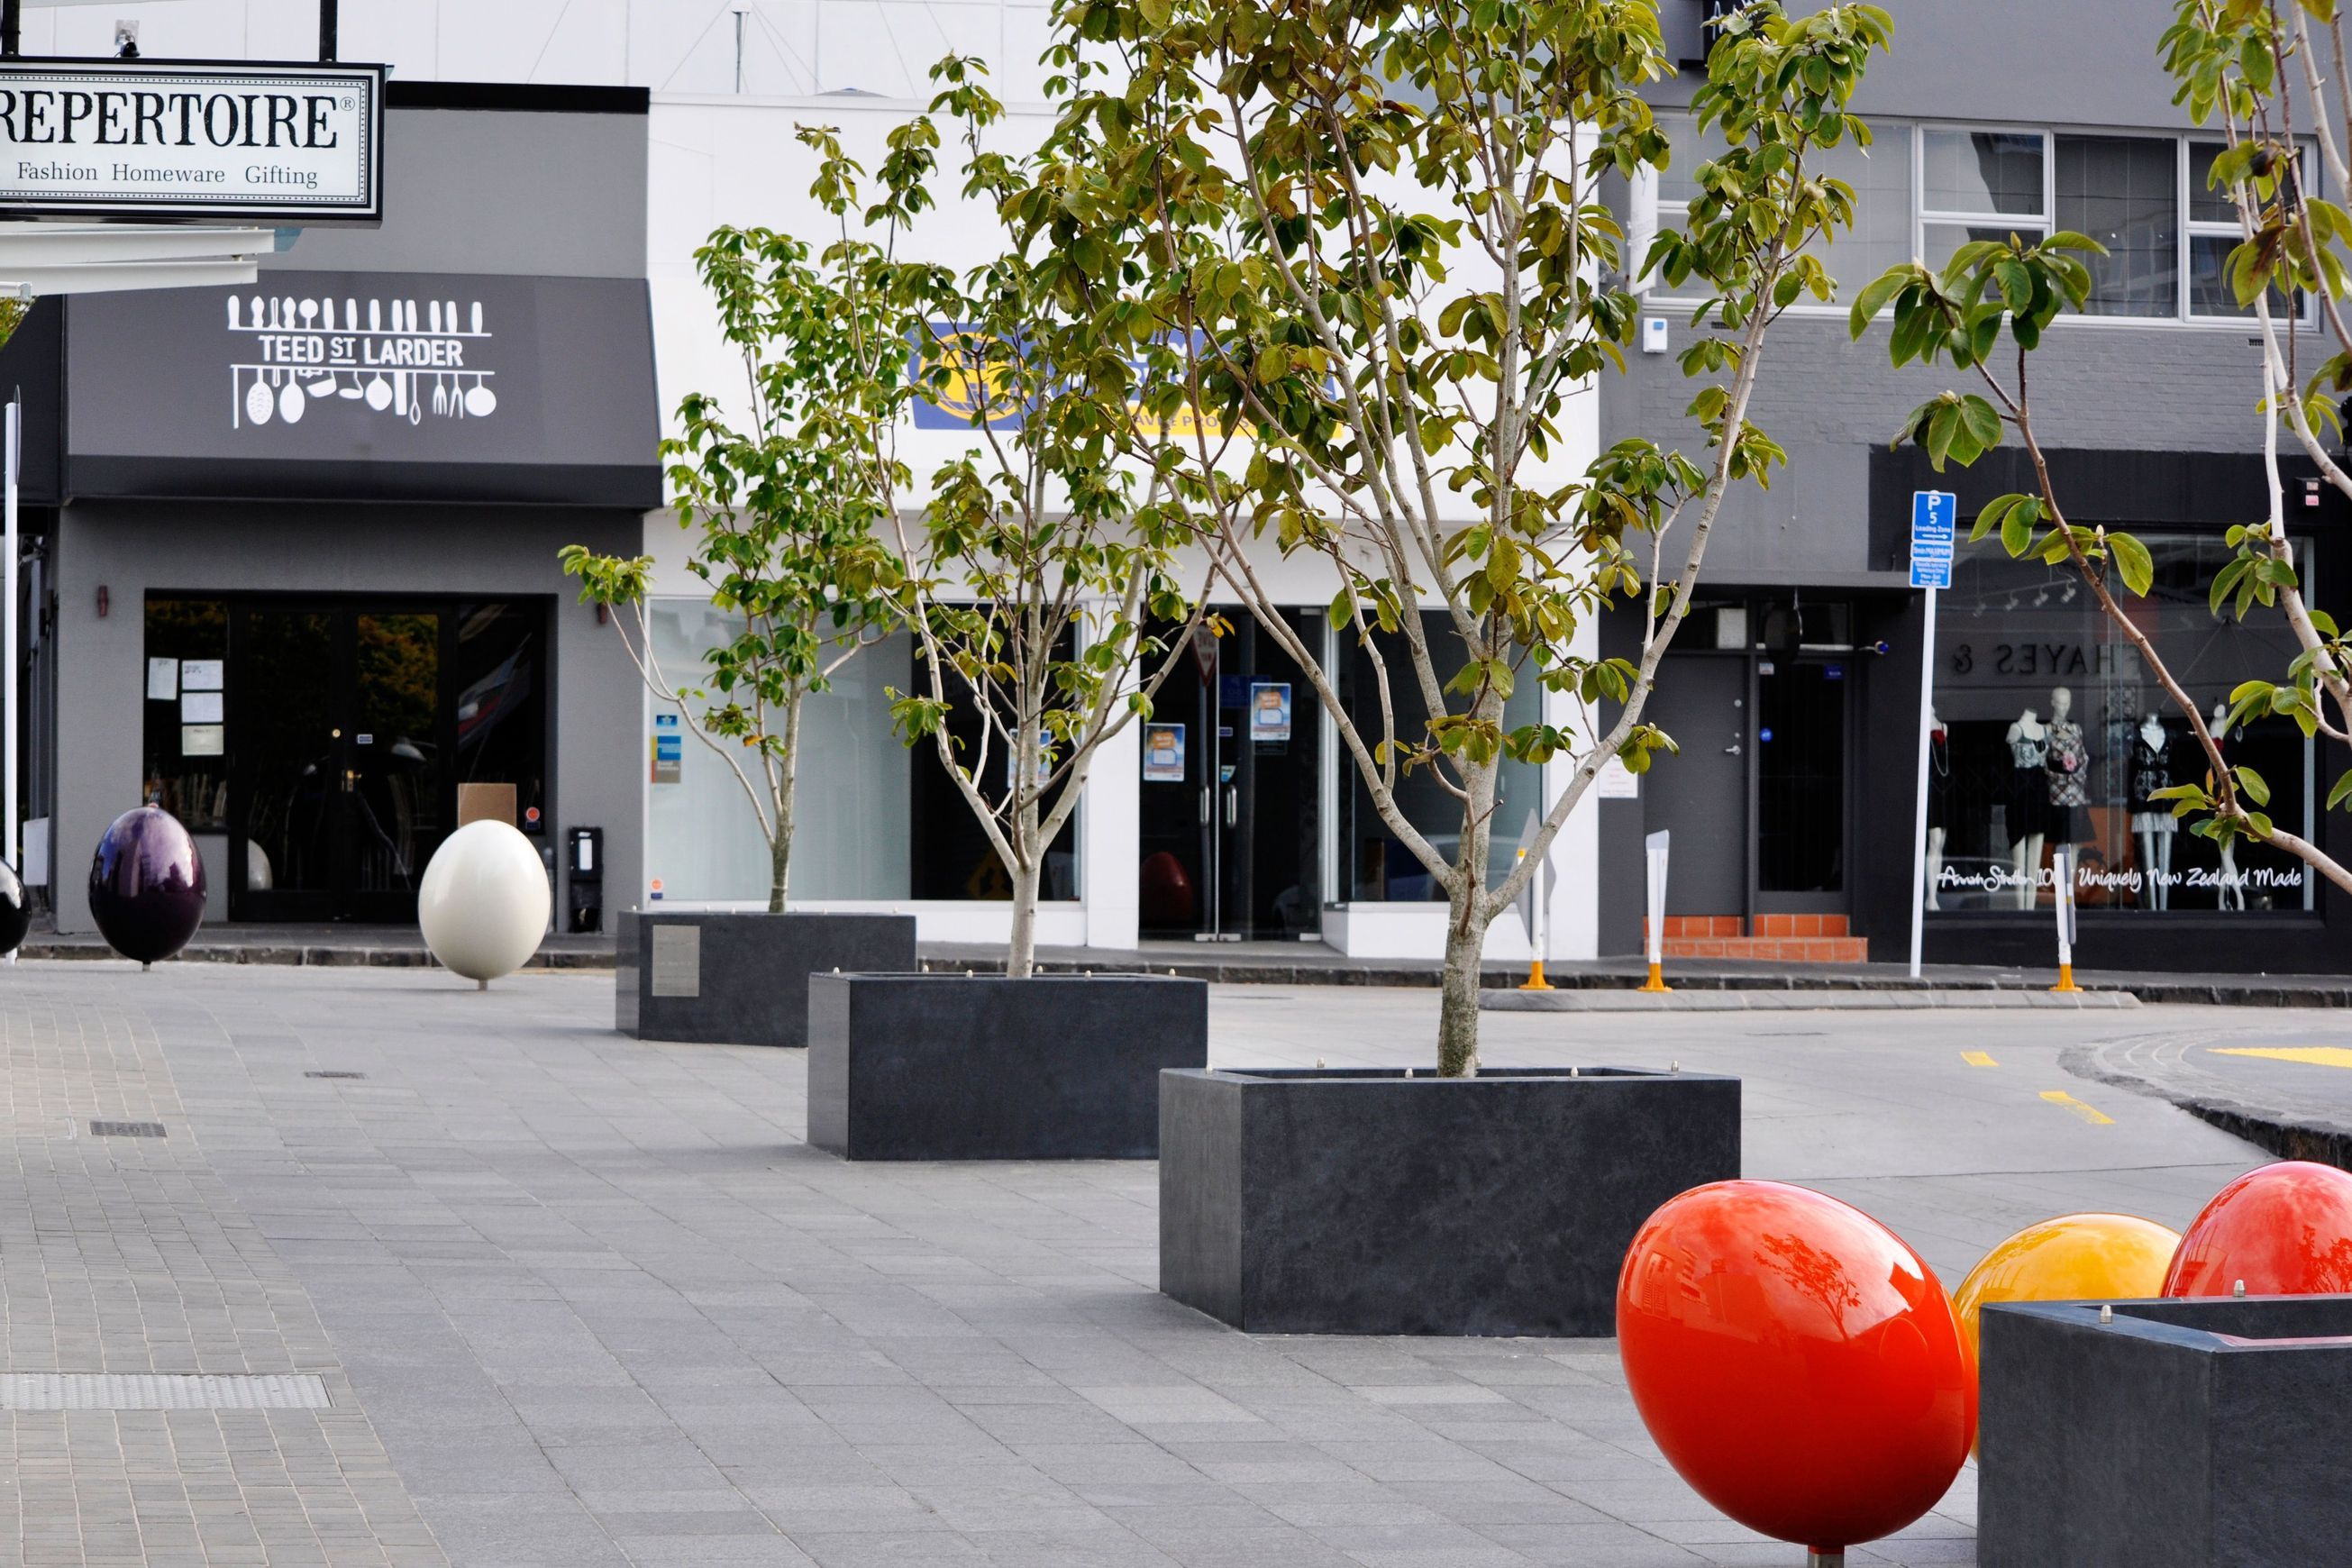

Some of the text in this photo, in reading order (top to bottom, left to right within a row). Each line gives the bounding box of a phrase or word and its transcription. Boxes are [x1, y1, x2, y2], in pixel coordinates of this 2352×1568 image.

[17, 161, 318, 189] Fashion Homeware Gifting
[258, 335, 464, 367] TEED ST LARDER
[1928, 495, 1941, 511] P
[1929, 512, 1937, 524] 5
[2078, 867, 2142, 893] Uniquely
[2146, 867, 2182, 887] New
[2185, 867, 2249, 887] Zealand
[2253, 867, 2302, 888] Made
